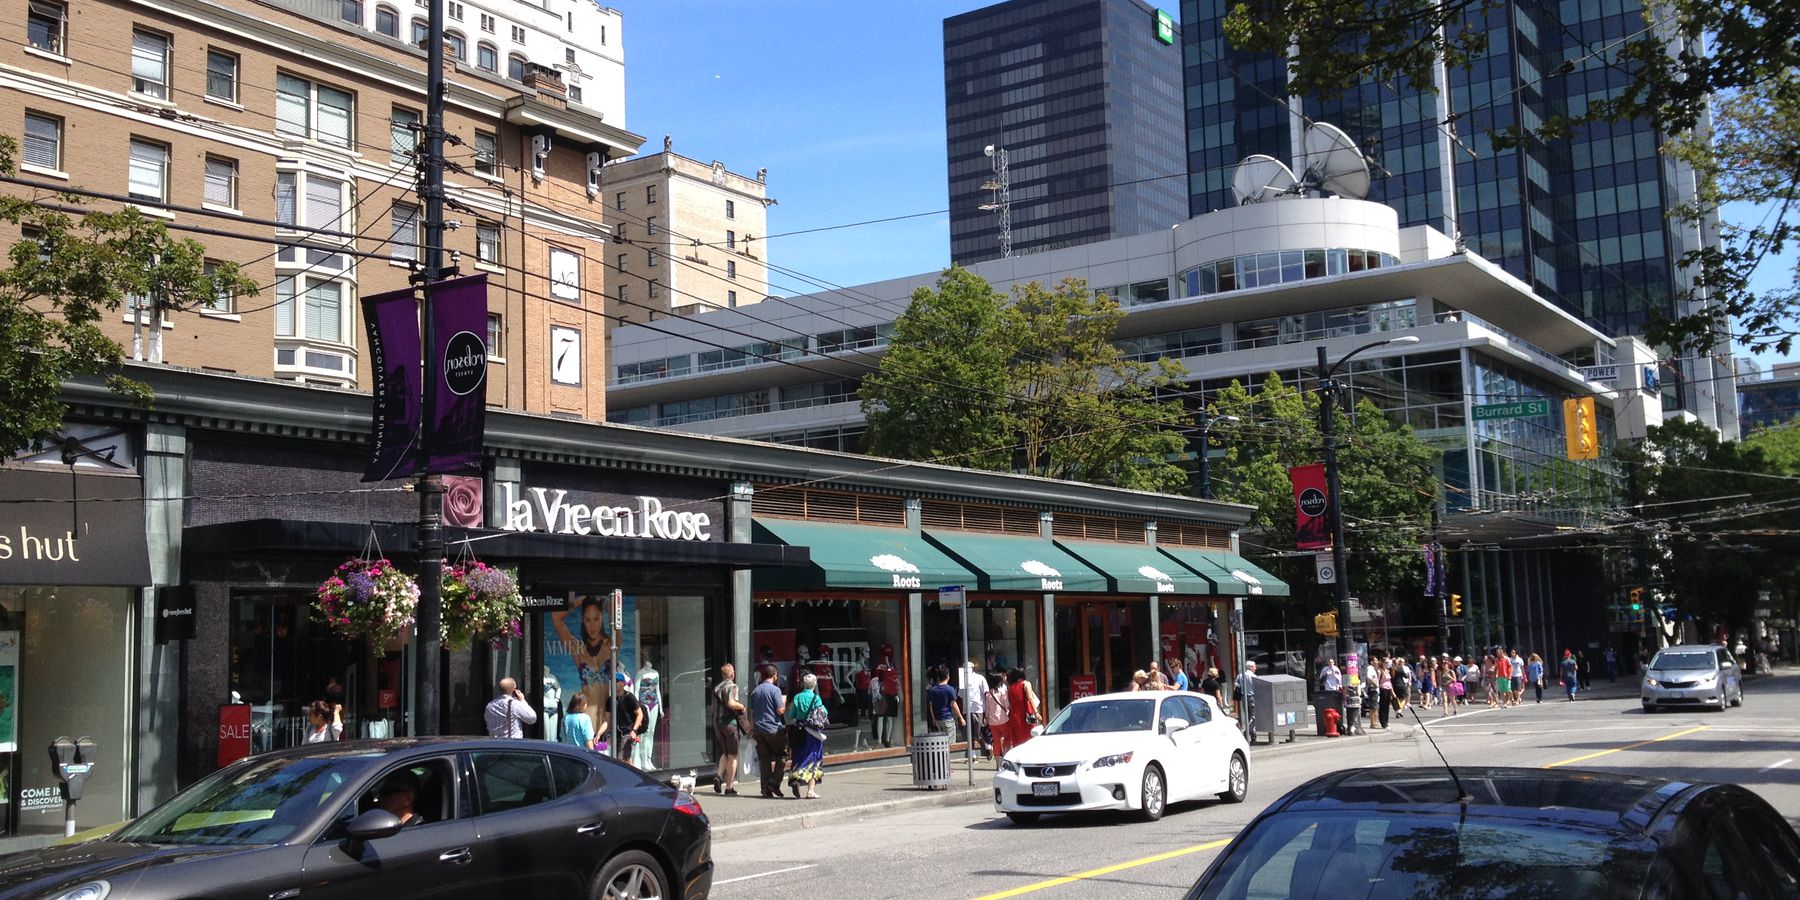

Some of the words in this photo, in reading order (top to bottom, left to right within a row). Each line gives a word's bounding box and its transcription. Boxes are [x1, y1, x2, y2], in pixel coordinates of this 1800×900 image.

[556, 337, 575, 373] 7
[1587, 367, 1616, 377] POWER
[1475, 403, 1523, 418] Burrard
[1528, 402, 1544, 414] St
[499, 481, 536, 532] la
[592, 504, 637, 538] en
[635, 495, 711, 542] Rose
[21, 526, 79, 562] hut
[892, 574, 921, 588] Roots
[1041, 578, 1063, 591] Roots
[544, 639, 588, 656] MMER
[220, 724, 249, 739] SALE
[21, 788, 51, 798] COME
